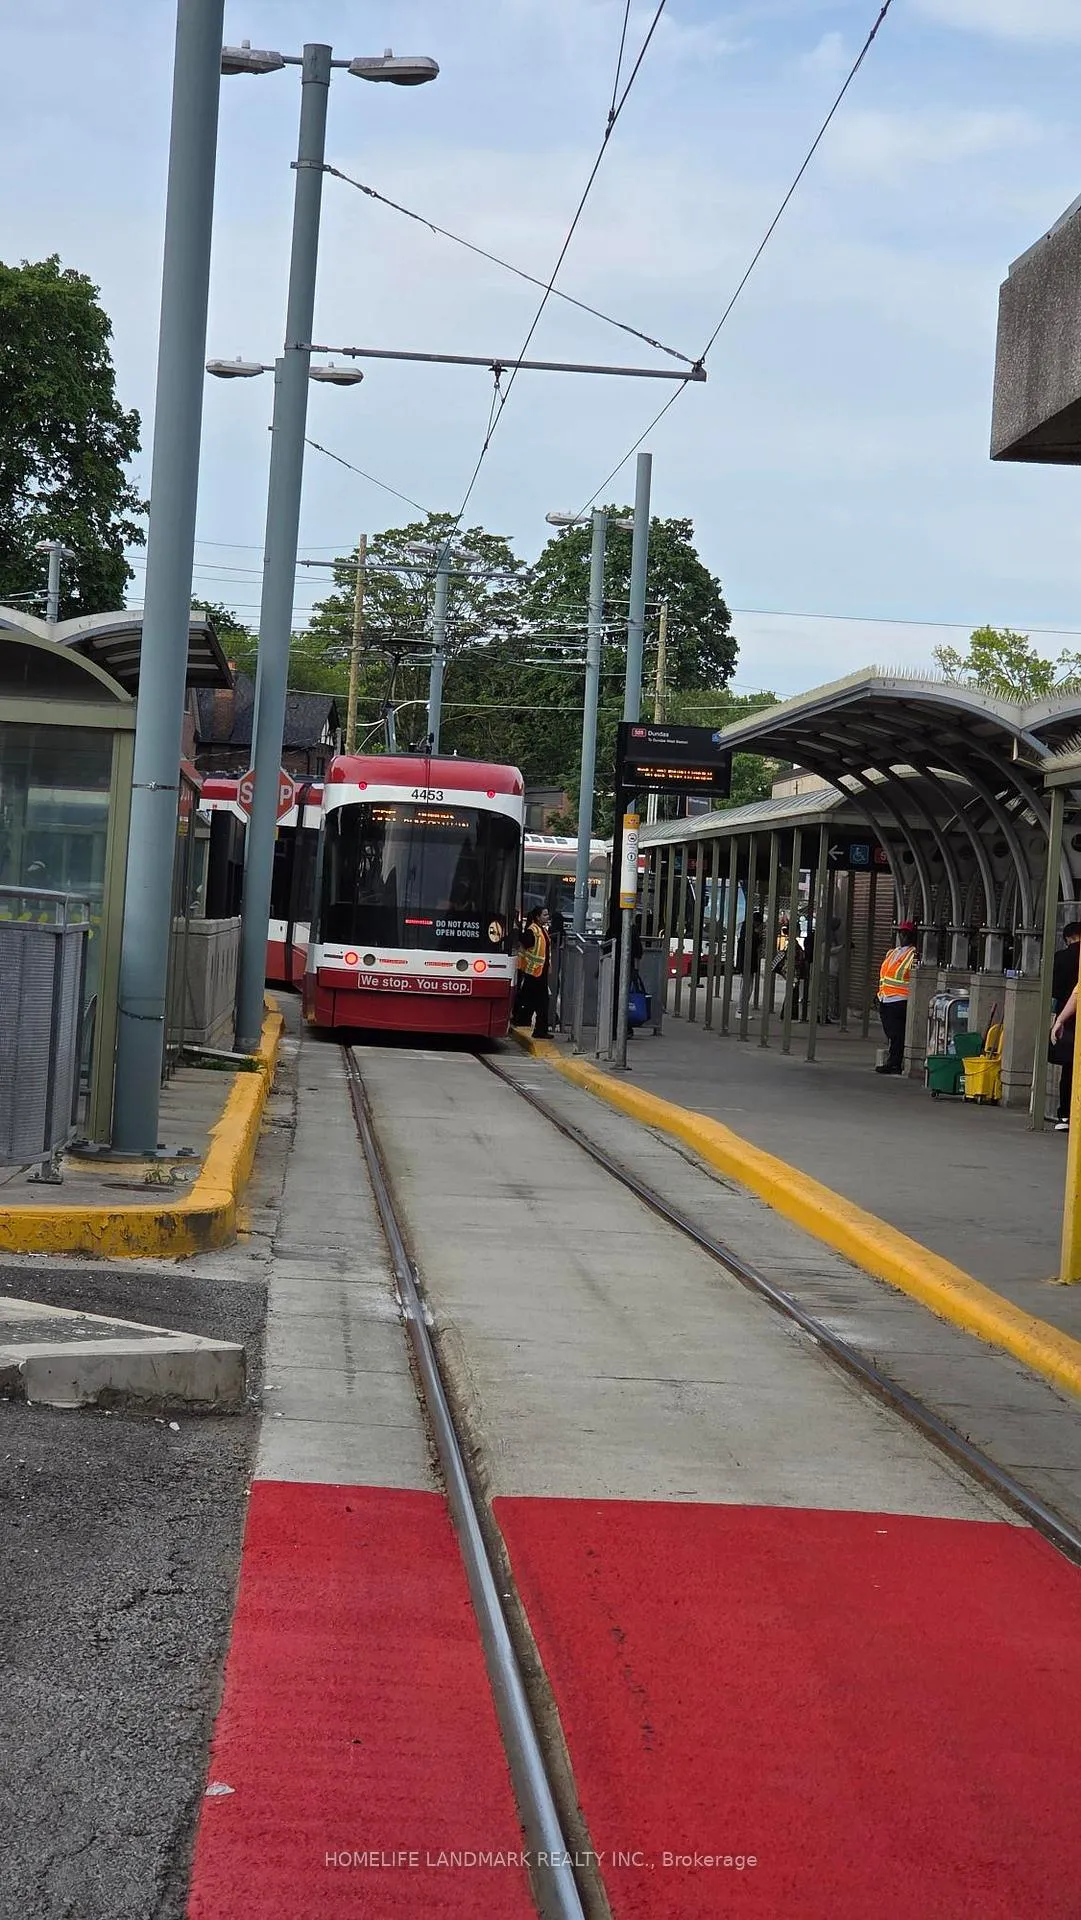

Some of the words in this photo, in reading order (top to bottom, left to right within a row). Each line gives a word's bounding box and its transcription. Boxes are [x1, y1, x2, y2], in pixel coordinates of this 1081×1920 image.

[647, 730, 669, 738] Dundas
[240, 781, 293, 805] SP
[411, 789, 444, 801] 4453
[436, 920, 446, 928] DO
[447, 920, 461, 928] NOT
[462, 921, 480, 929] PASS
[435, 928, 455, 937] OPEN
[456, 929, 480, 938] DOORS
[360, 974, 379, 986] We
[382, 977, 412, 990] stop.
[417, 978, 438, 989] You
[442, 980, 470, 993] stop.
